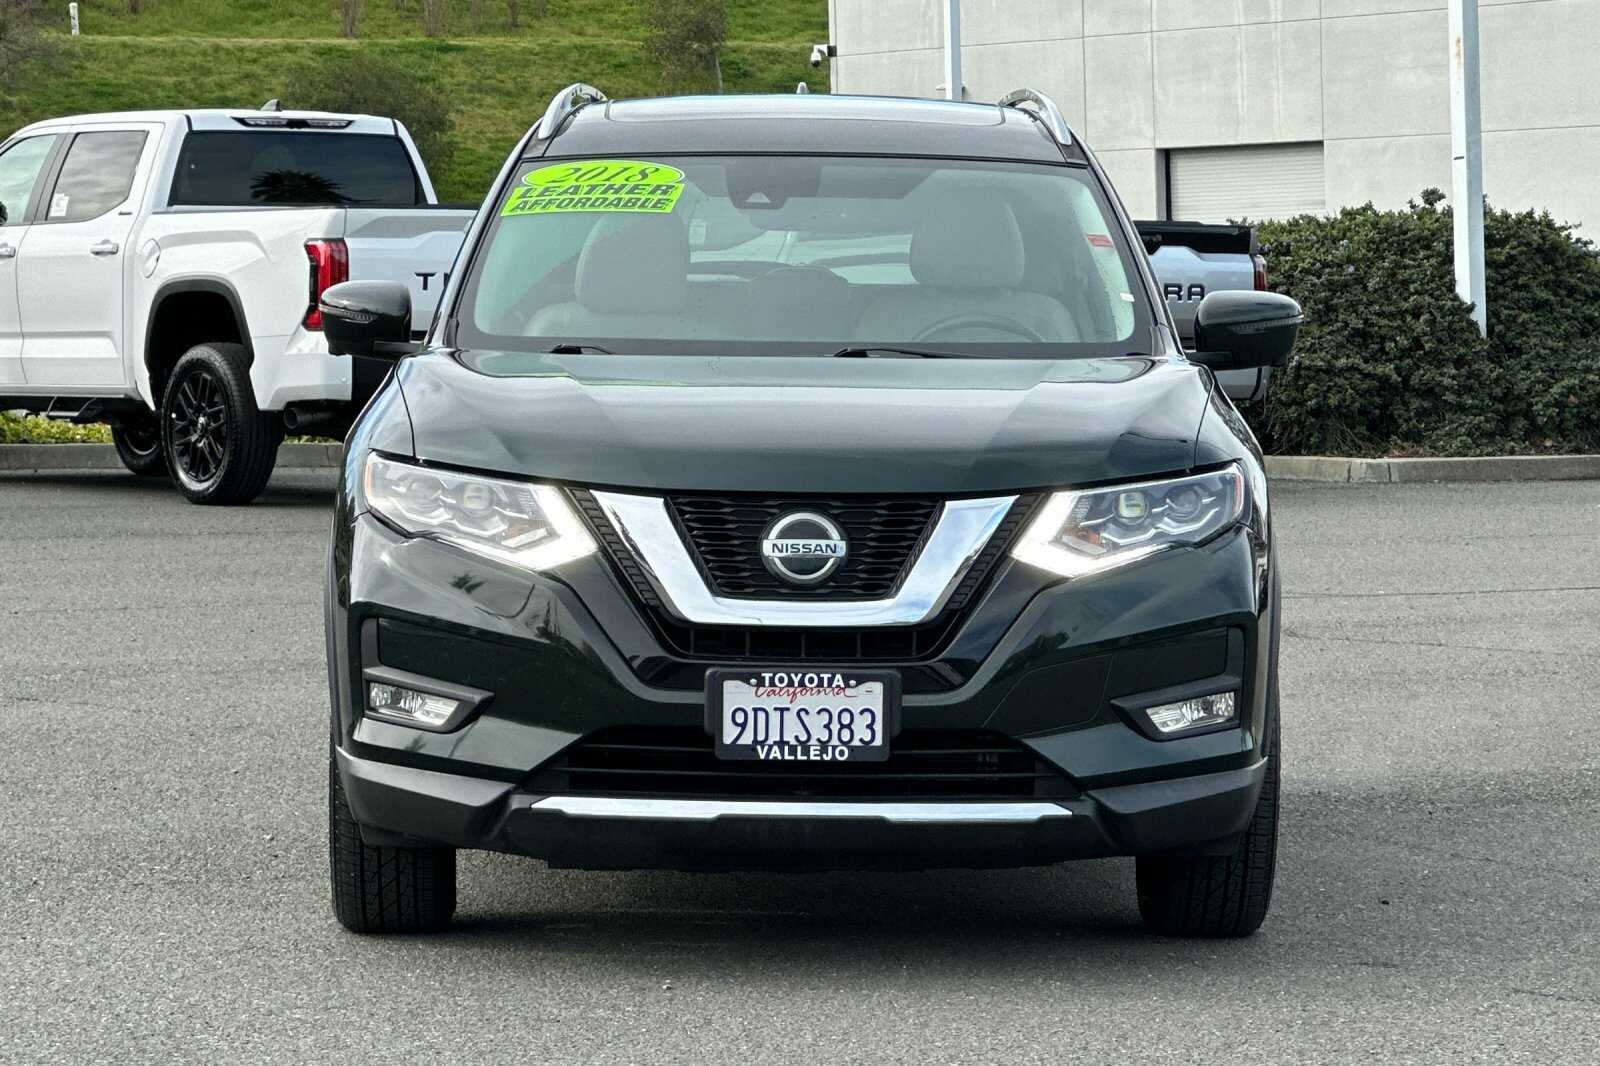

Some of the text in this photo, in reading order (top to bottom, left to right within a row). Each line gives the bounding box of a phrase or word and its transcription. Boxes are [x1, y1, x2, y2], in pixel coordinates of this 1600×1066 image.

[545, 165, 660, 184] 2018
[519, 183, 676, 198] LEATHER
[511, 197, 672, 212] AFFORDABLE
[414, 272, 451, 291] T
[772, 543, 837, 554] NISSAN
[761, 672, 845, 688] TOYOTA
[730, 706, 877, 746] 9DIS383
[756, 745, 849, 760] VALLEJO
